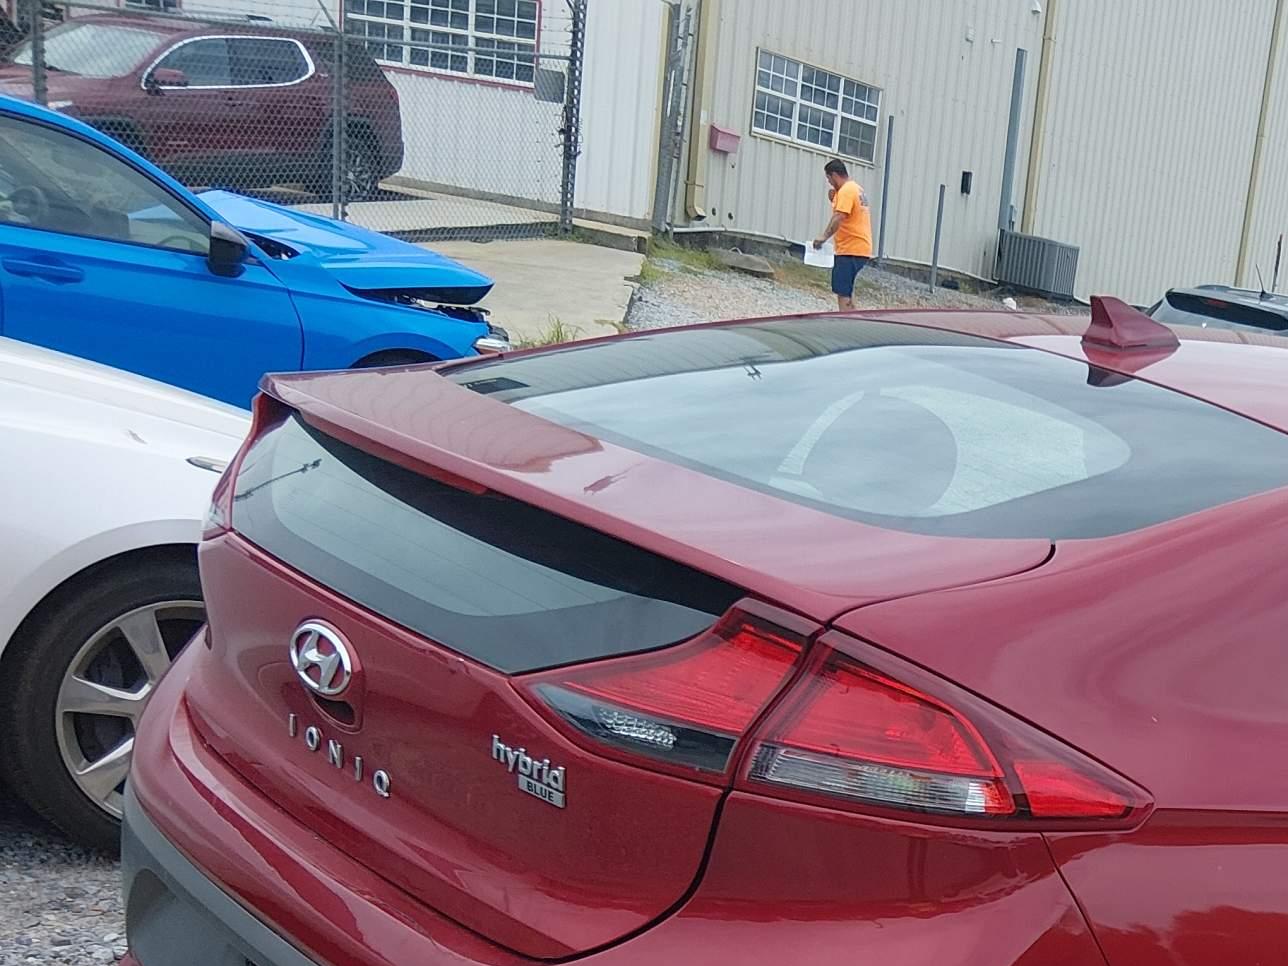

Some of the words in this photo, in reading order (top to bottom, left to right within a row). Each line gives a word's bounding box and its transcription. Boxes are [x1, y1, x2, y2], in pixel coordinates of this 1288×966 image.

[289, 713, 391, 798] IONIQ
[492, 734, 566, 792] hybrid
[526, 780, 555, 802] BLUE
